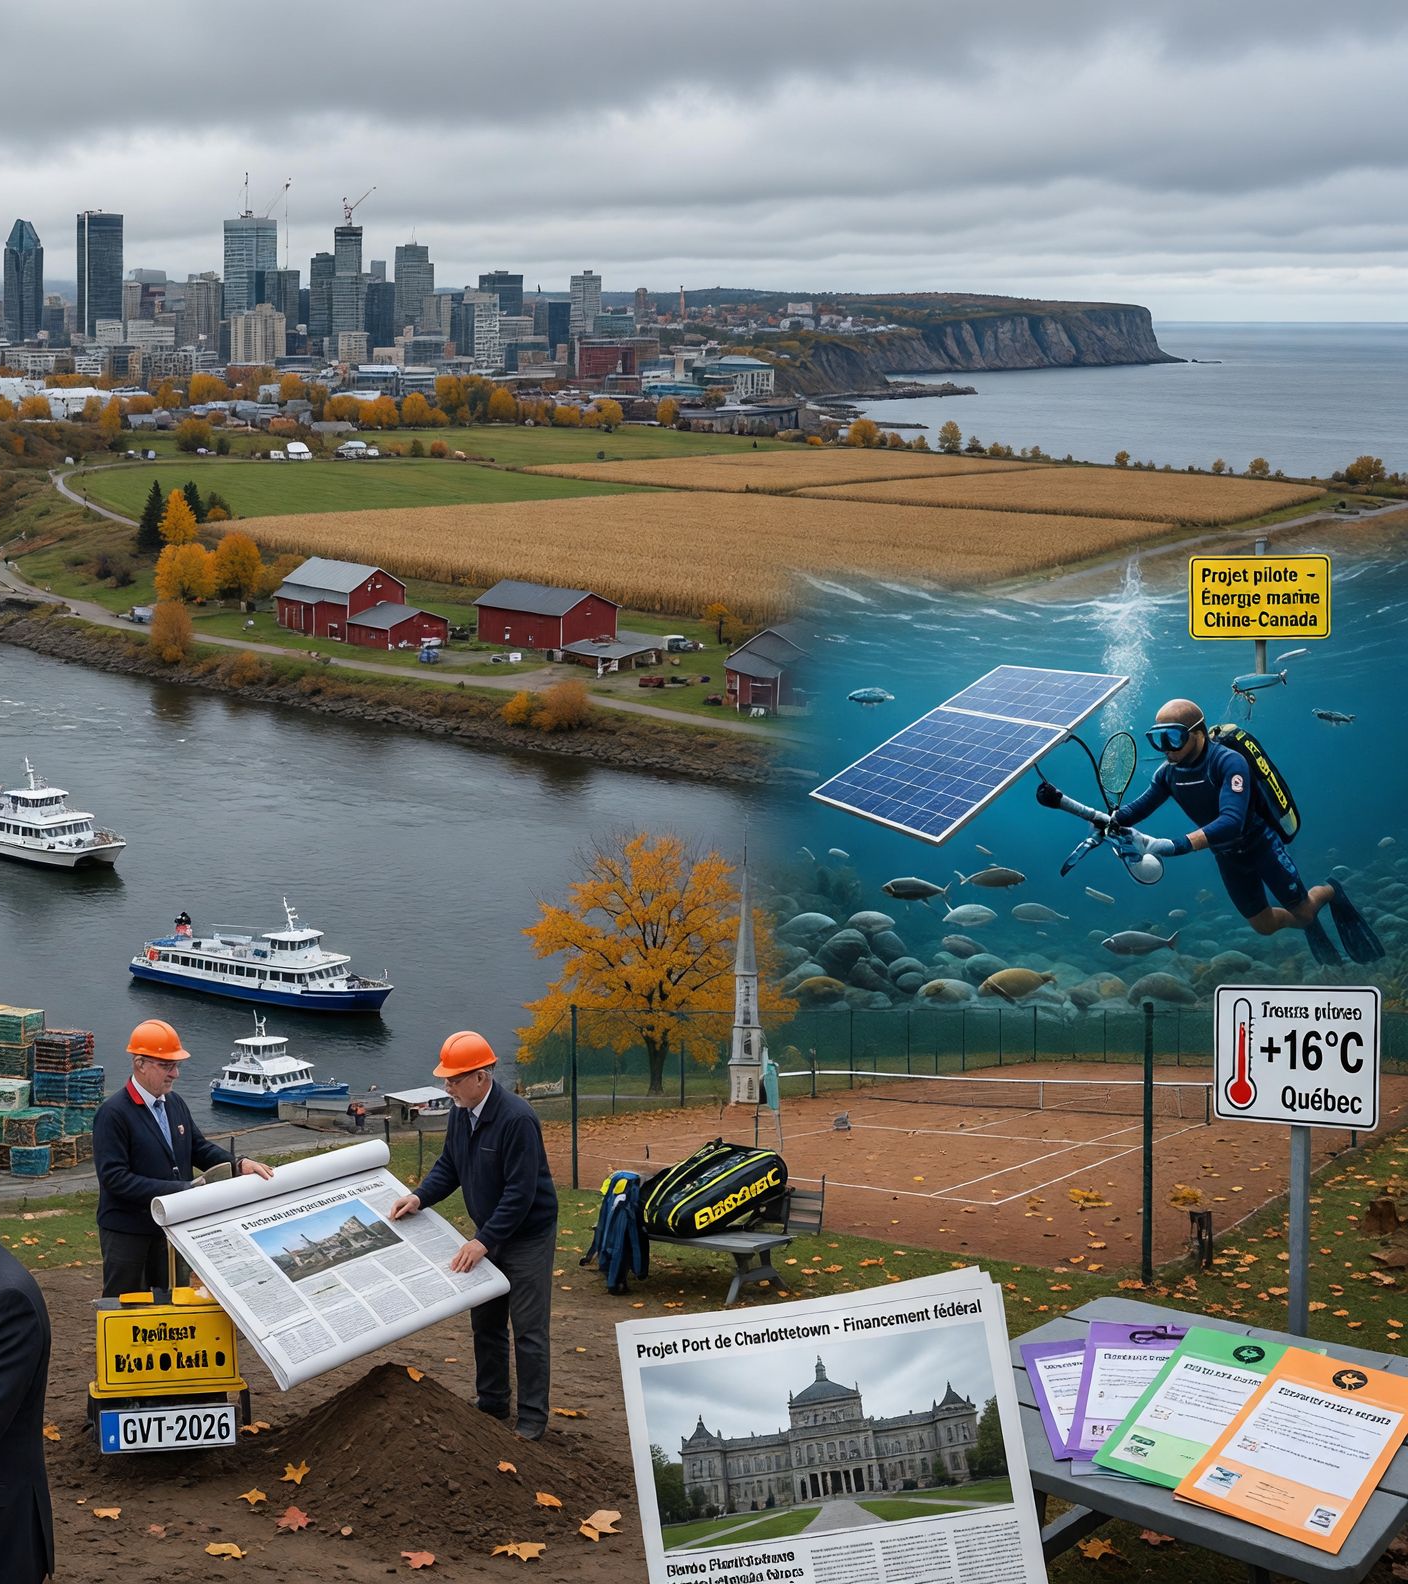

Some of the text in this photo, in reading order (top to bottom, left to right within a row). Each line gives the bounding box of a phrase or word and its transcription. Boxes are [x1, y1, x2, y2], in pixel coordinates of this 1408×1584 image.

[1201, 567, 1249, 587] Projet
[1253, 566, 1298, 586] pilote
[1204, 611, 1318, 628] Chine-Canada
[1260, 1029, 1364, 1074] +16°C
[1281, 1085, 1363, 1115] Québec
[636, 1341, 679, 1360] Projet
[682, 1336, 712, 1353] Port
[714, 1334, 732, 1349] de
[734, 1323, 831, 1346] Charlottetown
[842, 1307, 931, 1332] Financement
[933, 1299, 983, 1319] fédéral
[123, 1412, 231, 1445] GVT-2026
